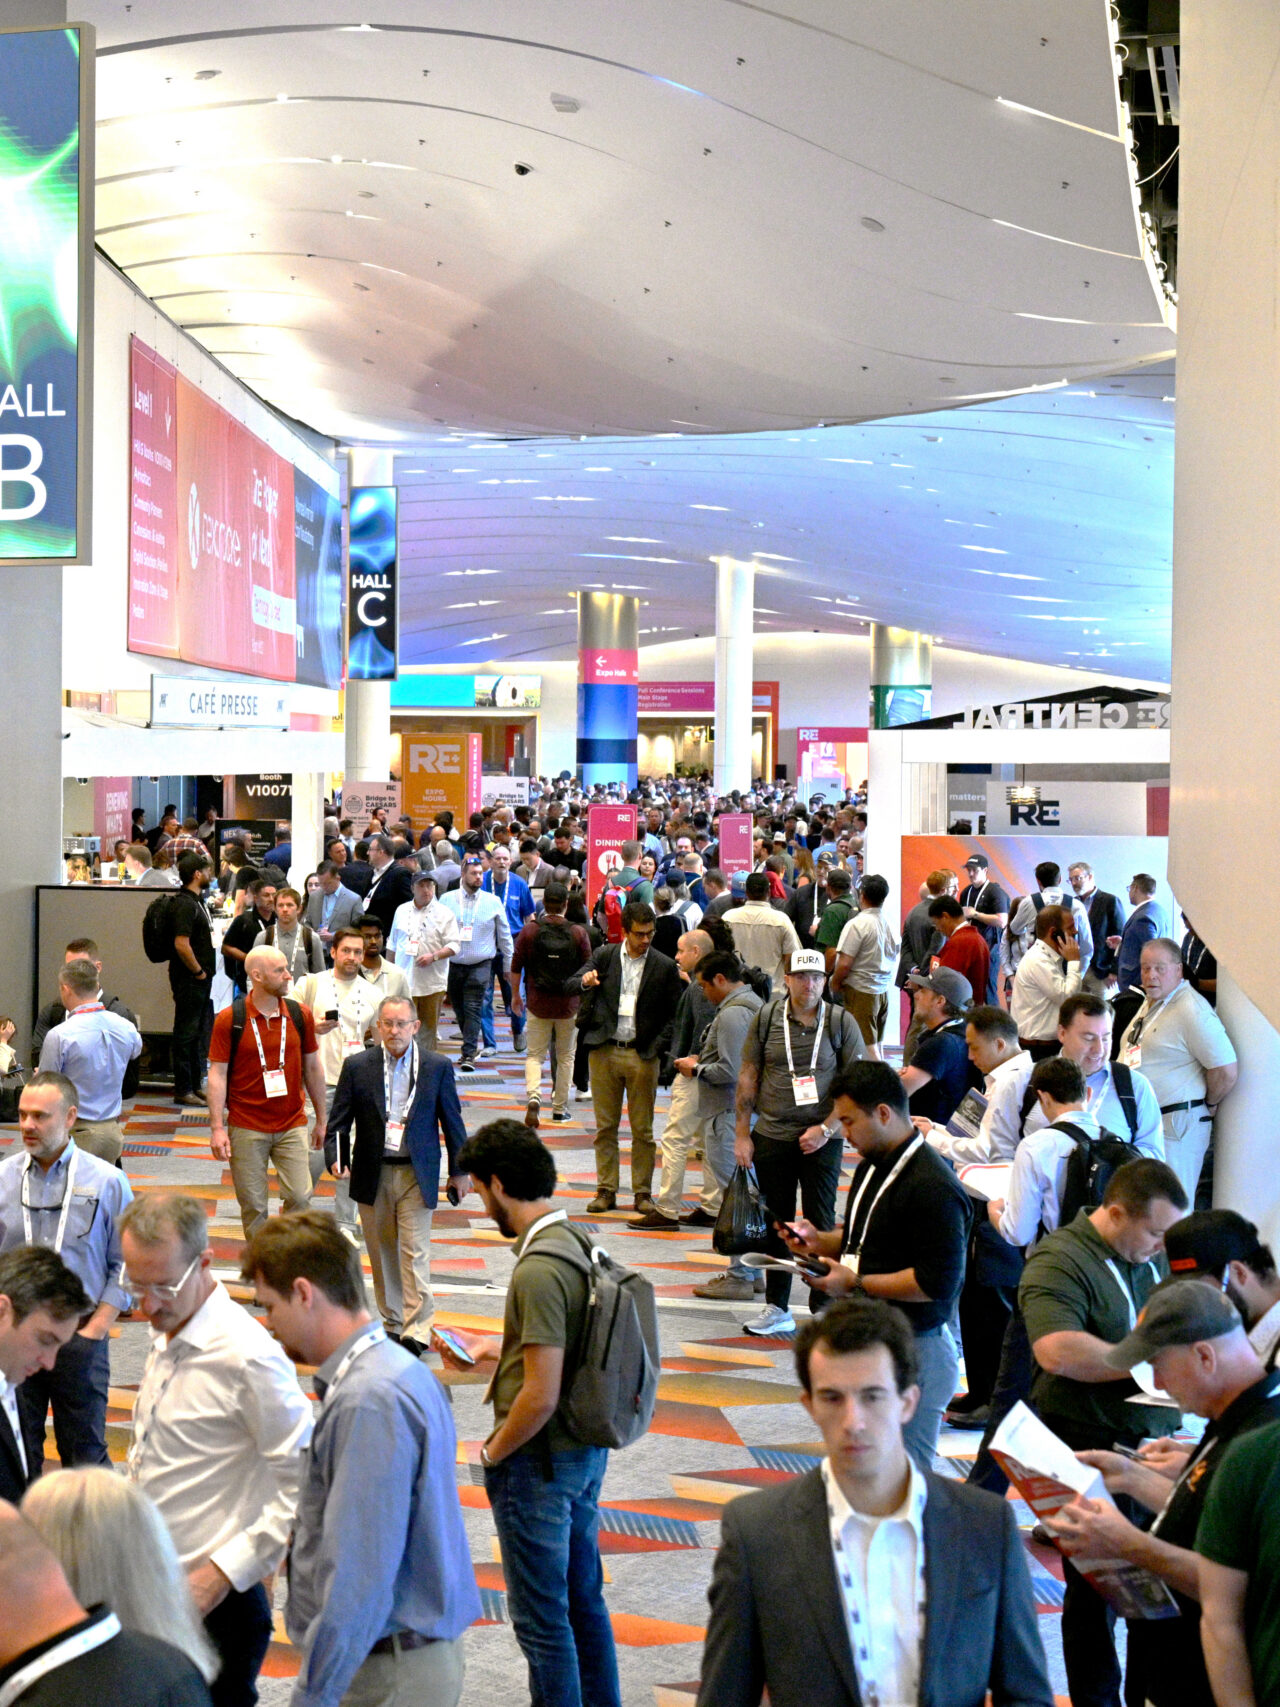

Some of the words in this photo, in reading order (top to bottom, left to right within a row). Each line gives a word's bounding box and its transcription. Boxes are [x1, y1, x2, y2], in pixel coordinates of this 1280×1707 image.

[134, 383, 150, 416] Level
[352, 574, 392, 589] HALL
[357, 591, 387, 627] C
[595, 669, 613, 677] Expo
[189, 686, 216, 714] CAFÉ
[221, 694, 259, 716] PRESSE
[949, 793, 986, 801] matters
[797, 956, 820, 965] FURA
